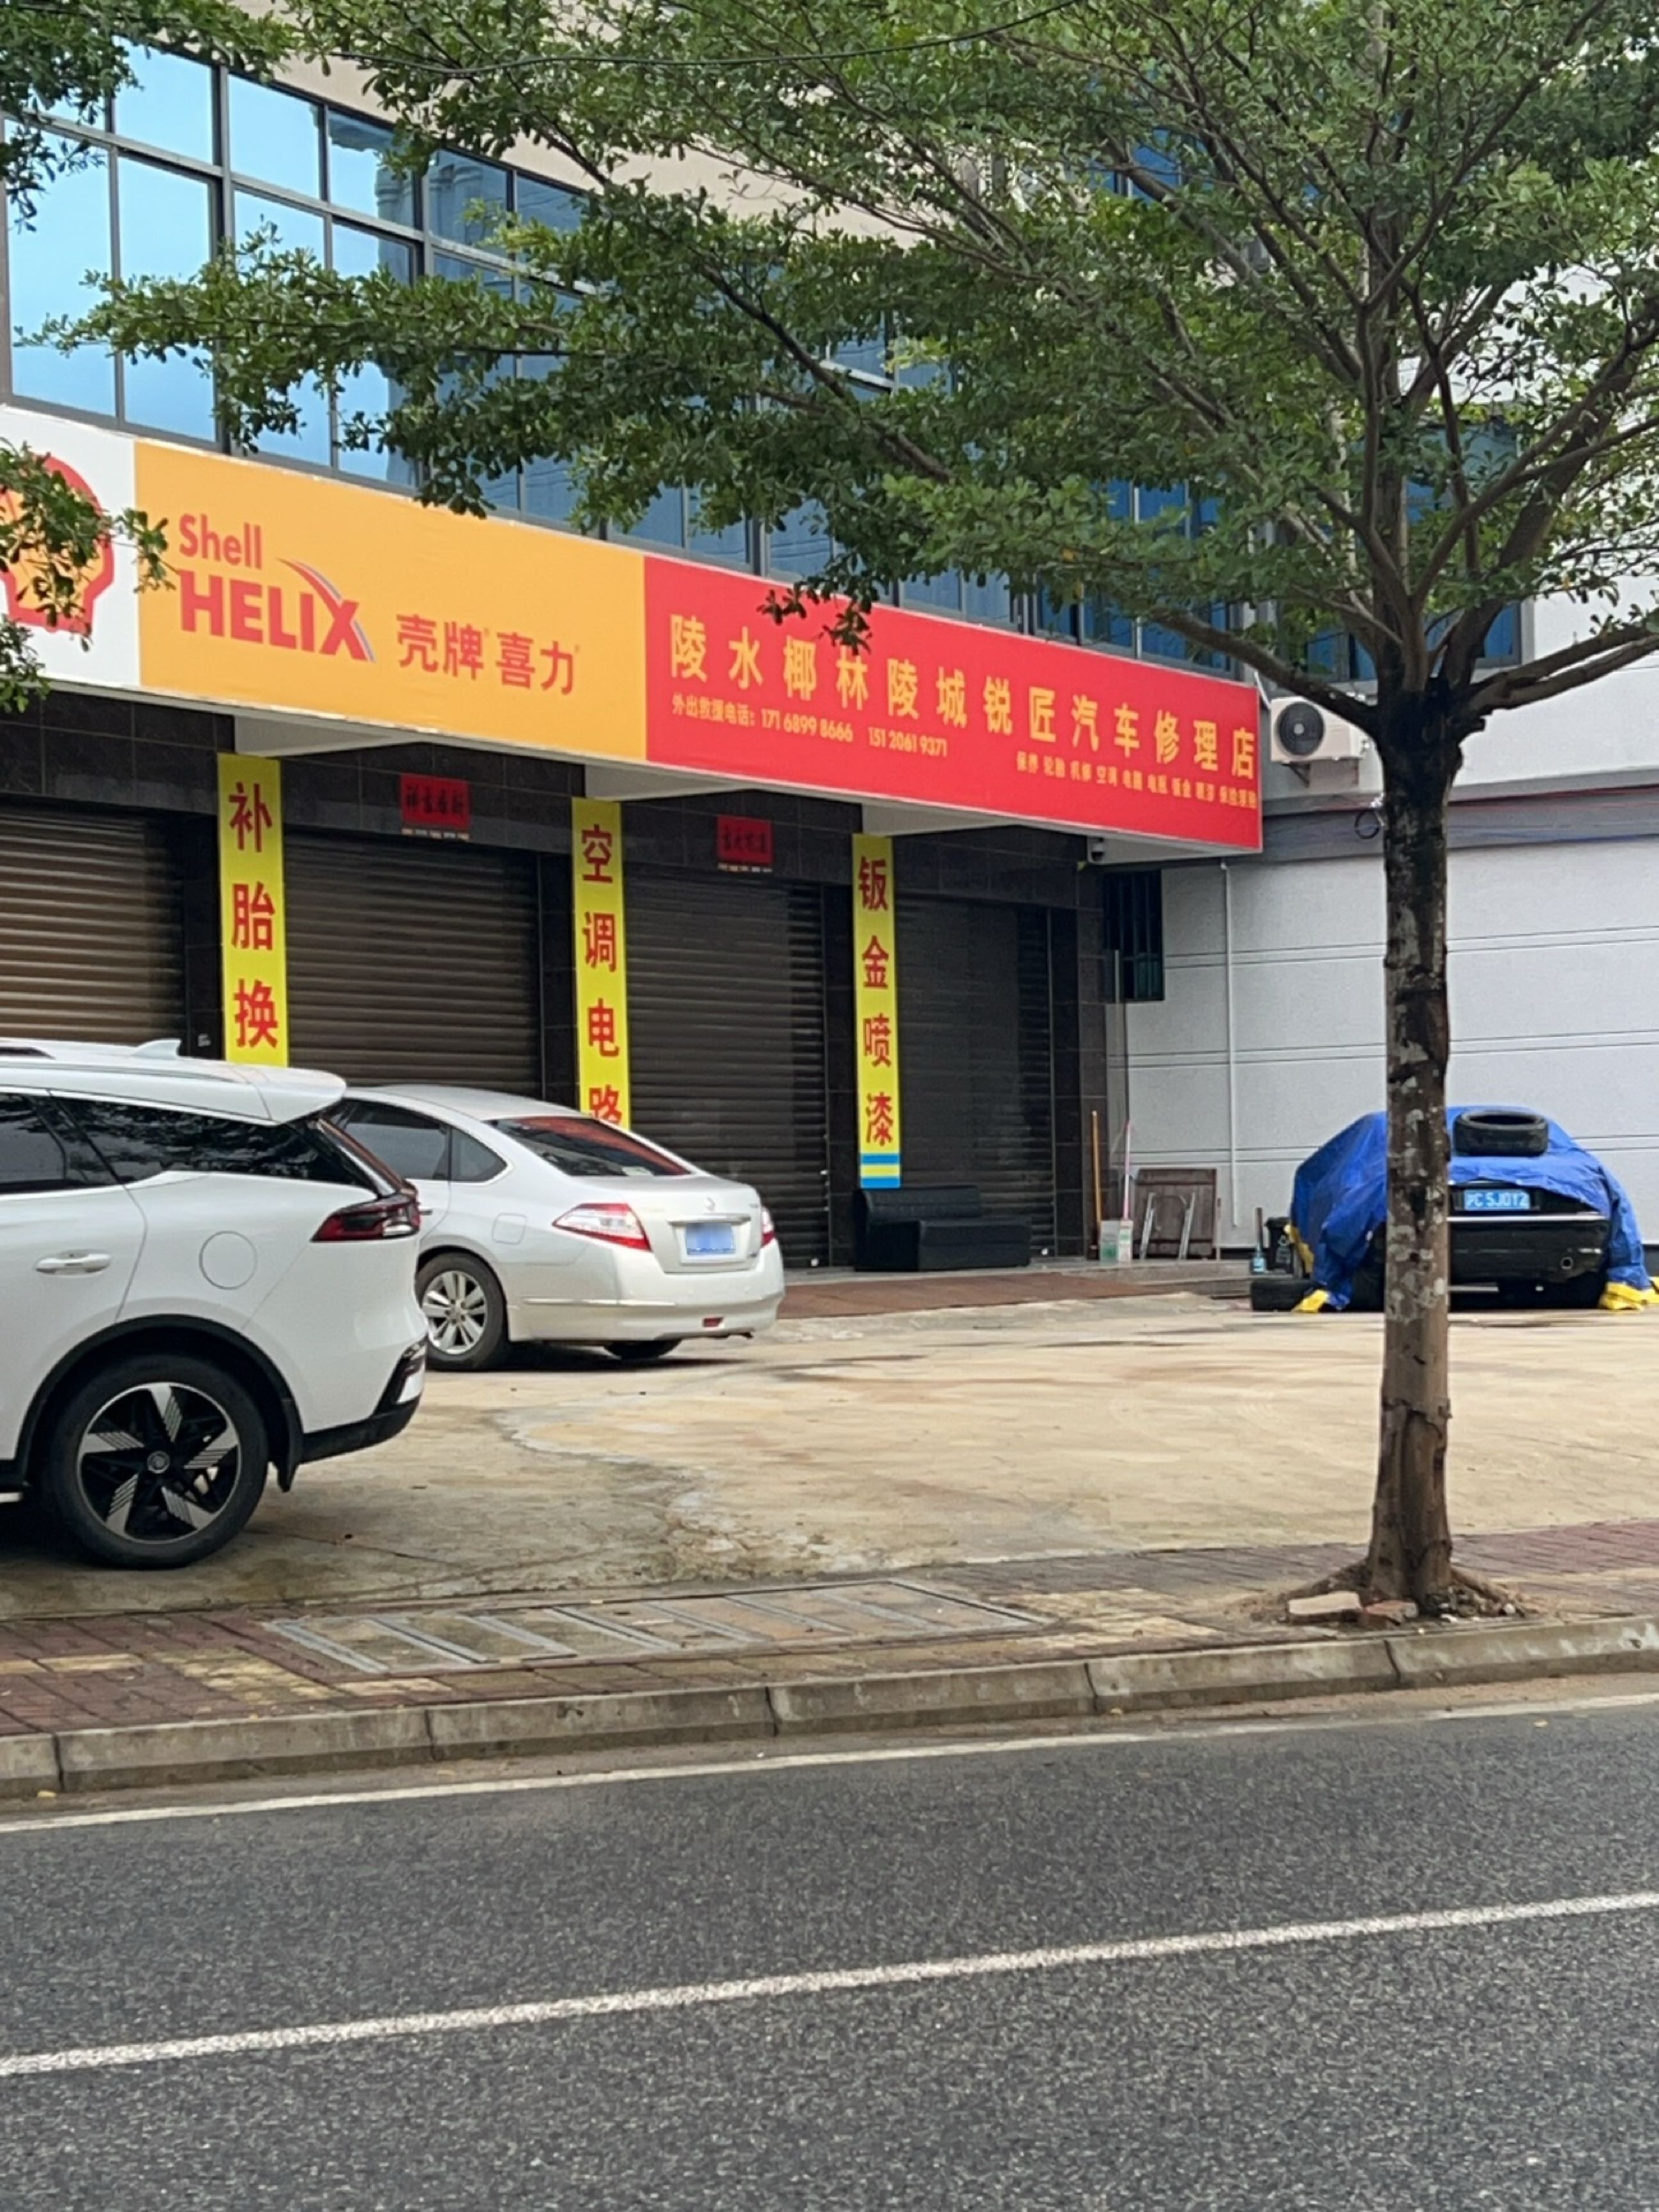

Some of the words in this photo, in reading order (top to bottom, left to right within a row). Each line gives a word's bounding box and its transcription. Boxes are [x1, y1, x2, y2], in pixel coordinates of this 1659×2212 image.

[179, 513, 262, 569] Shell
[179, 560, 376, 662] HELIX
[669, 613, 1256, 780] 陵水椰林陵城锐匠汽车修理店
[783, 712, 817, 736] 6899
[820, 718, 853, 742] 8666
[858, 856, 894, 1146] 钣金喷漆
